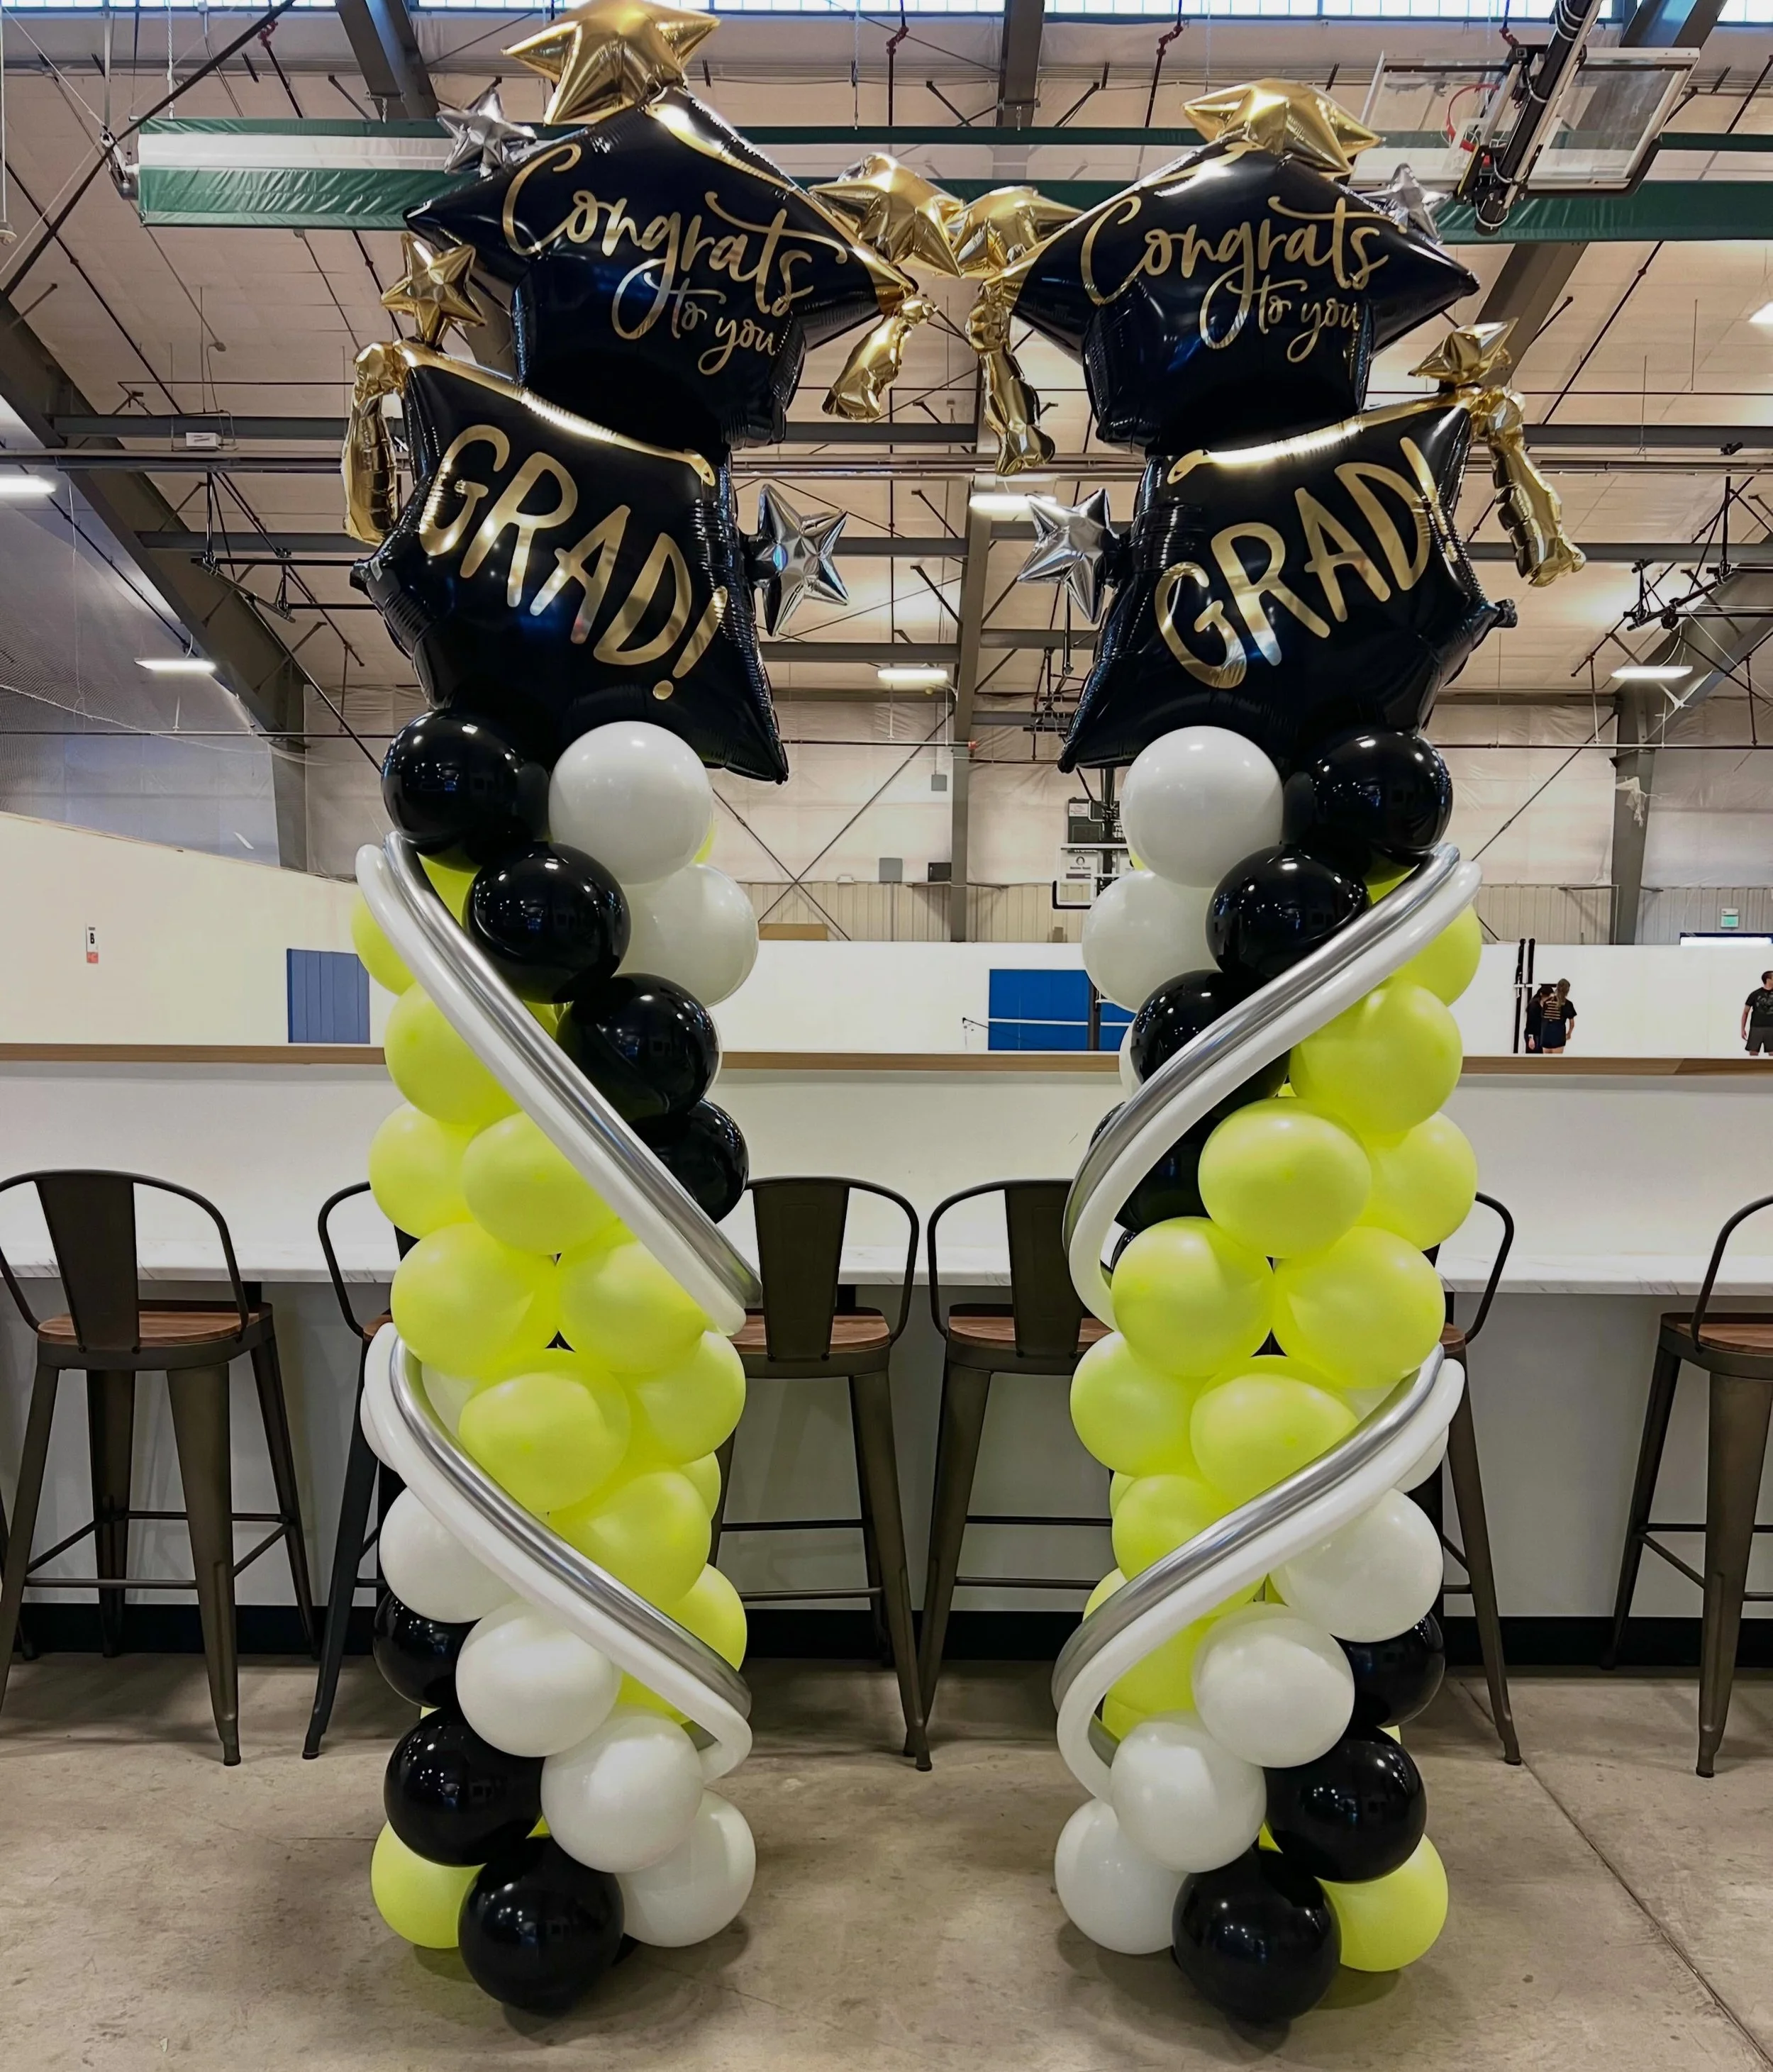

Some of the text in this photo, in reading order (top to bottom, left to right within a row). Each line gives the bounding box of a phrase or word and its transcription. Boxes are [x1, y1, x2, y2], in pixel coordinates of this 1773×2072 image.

[503, 143, 847, 339] Congrats
[1081, 195, 1407, 350] Congrats
[1225, 274, 1360, 363] to you
[643, 272, 776, 375] to you
[419, 424, 728, 701] GRAD!
